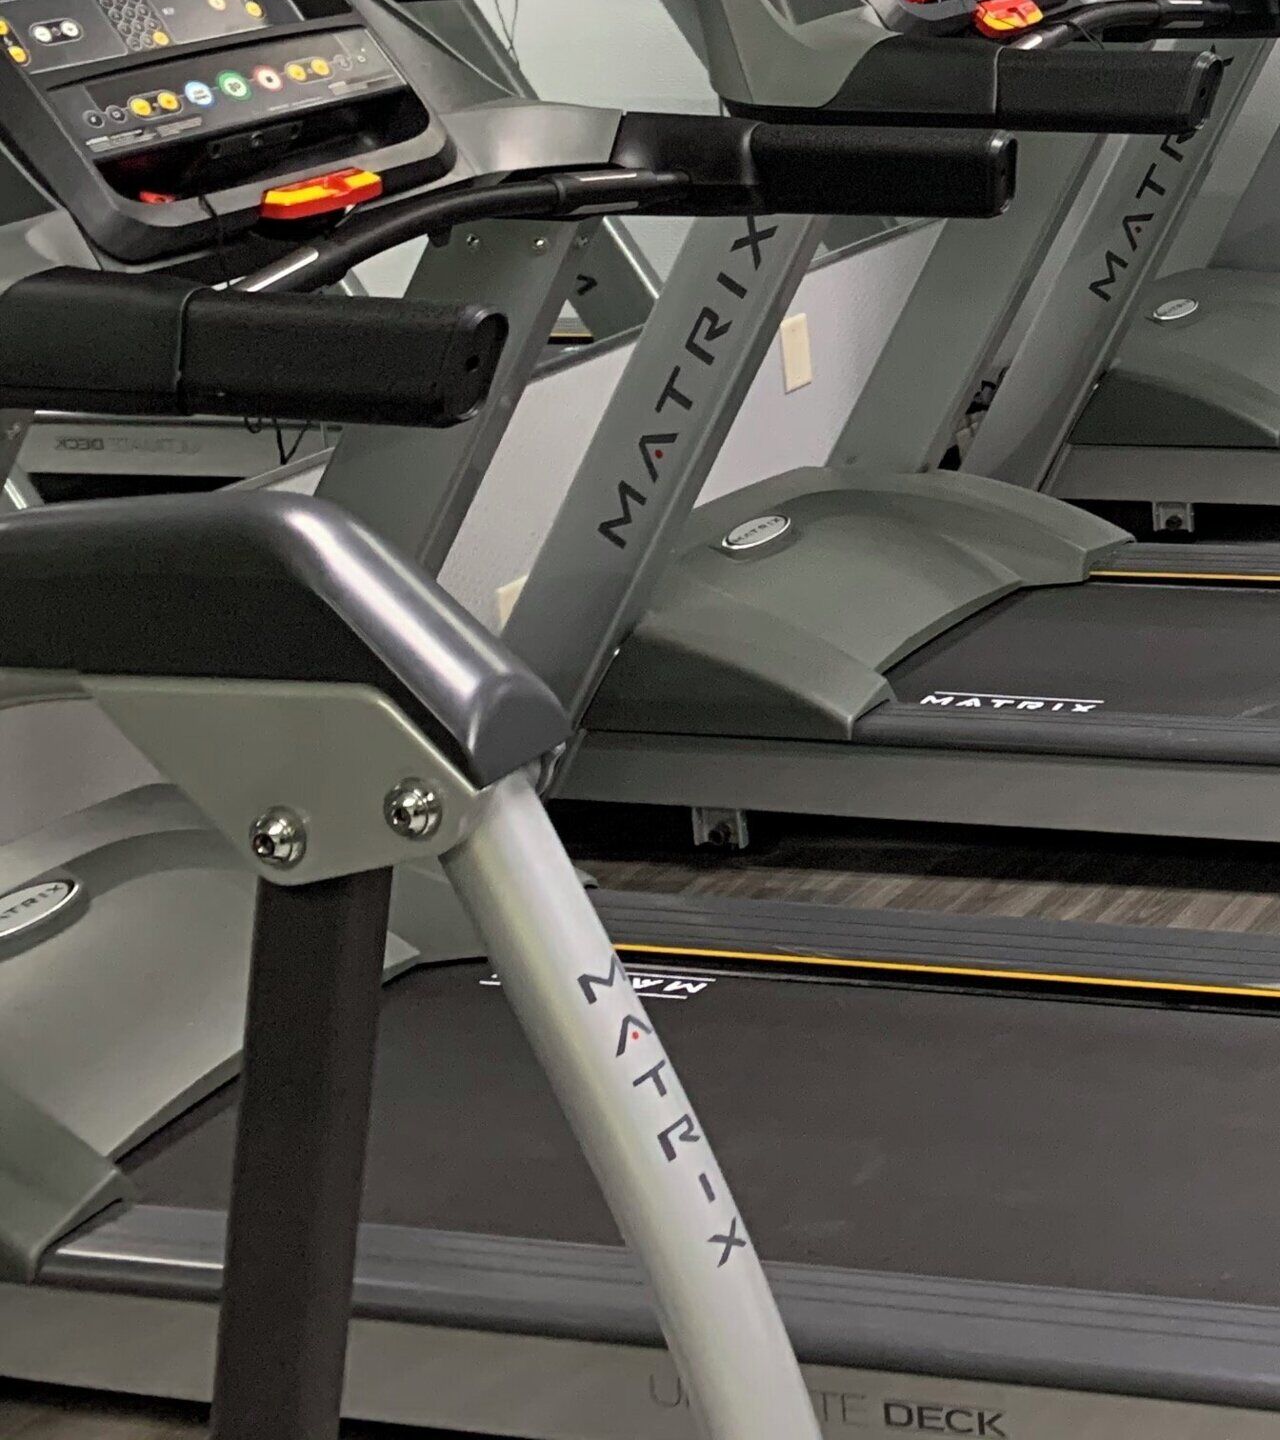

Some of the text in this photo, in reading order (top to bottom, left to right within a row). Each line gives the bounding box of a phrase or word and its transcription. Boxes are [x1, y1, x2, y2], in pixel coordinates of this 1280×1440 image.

[597, 215, 778, 549] MATRIX
[920, 694, 1097, 713] MATRIX
[578, 954, 746, 1268] MATRIX
[884, 1401, 1007, 1438] DECK
